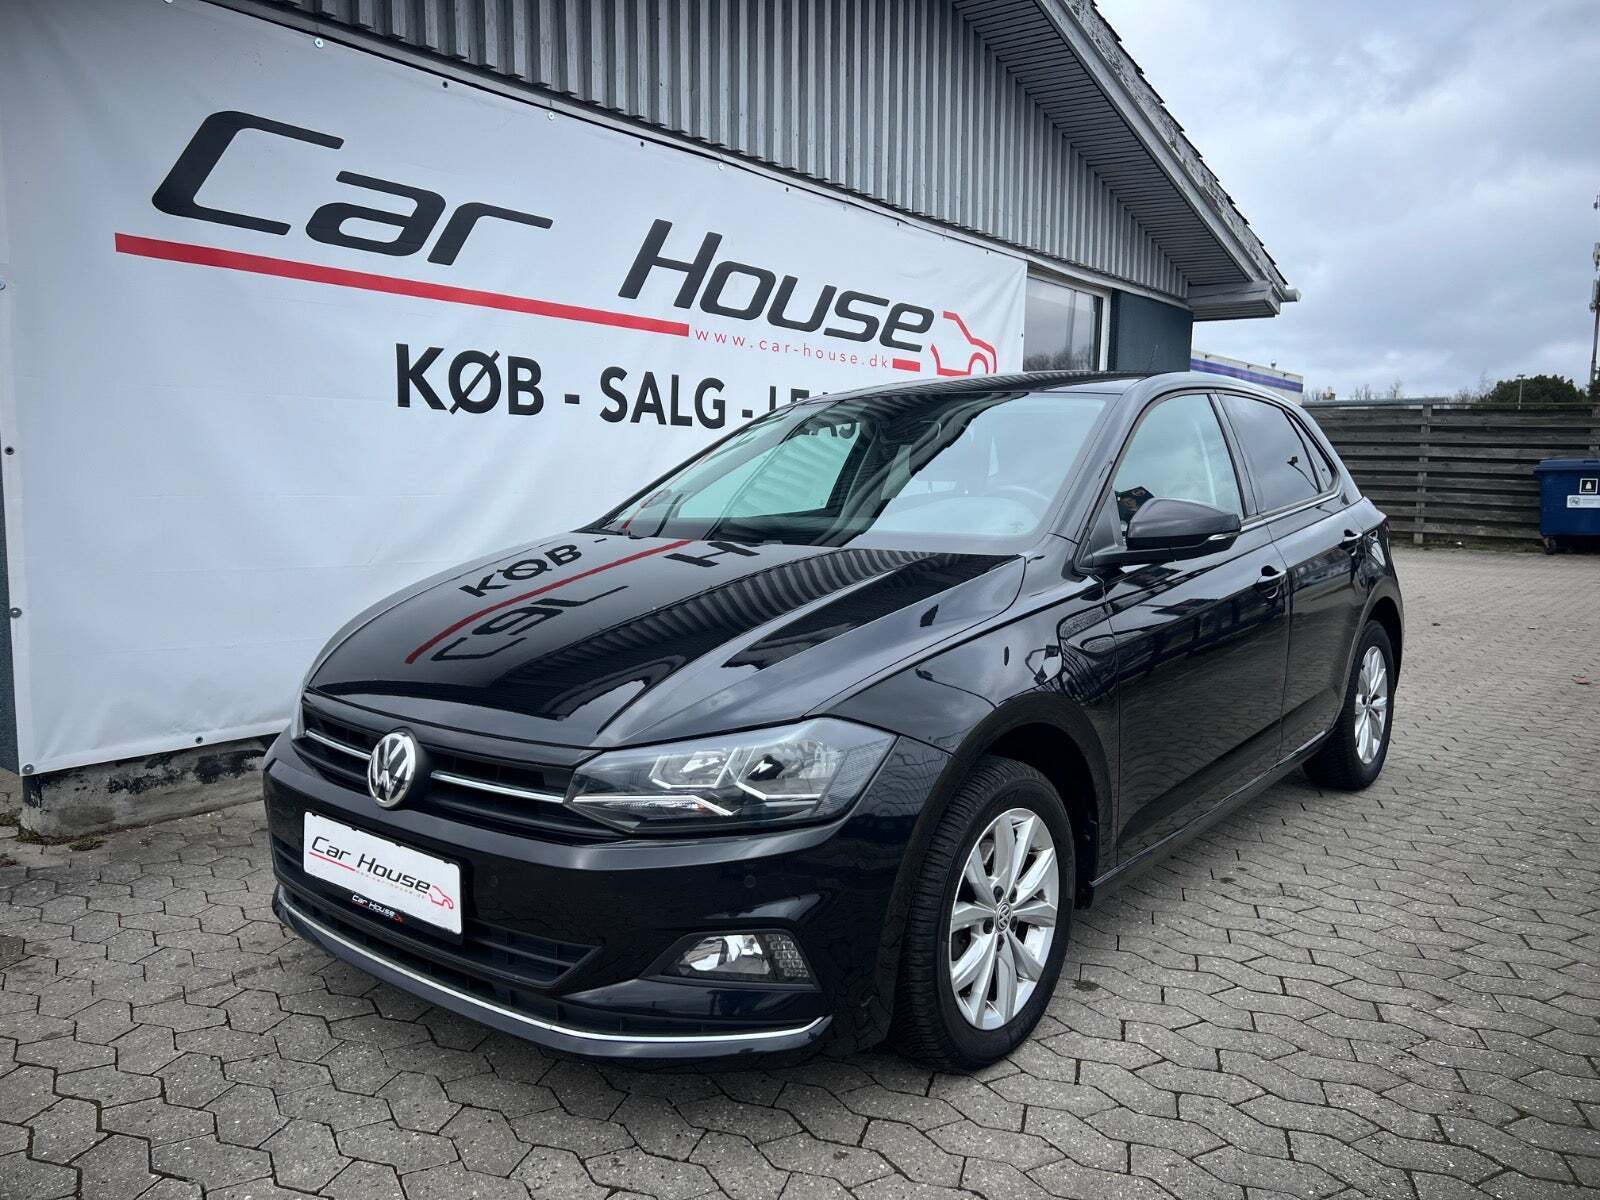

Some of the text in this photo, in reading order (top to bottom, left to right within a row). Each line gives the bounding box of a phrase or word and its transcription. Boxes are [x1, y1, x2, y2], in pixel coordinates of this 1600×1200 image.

[151, 110, 935, 353] Car House
[694, 329, 889, 369] www.car-house.dk
[395, 342, 545, 416] KØB
[599, 365, 726, 430] SALG
[311, 836, 352, 861] Car
[356, 853, 432, 895] House
